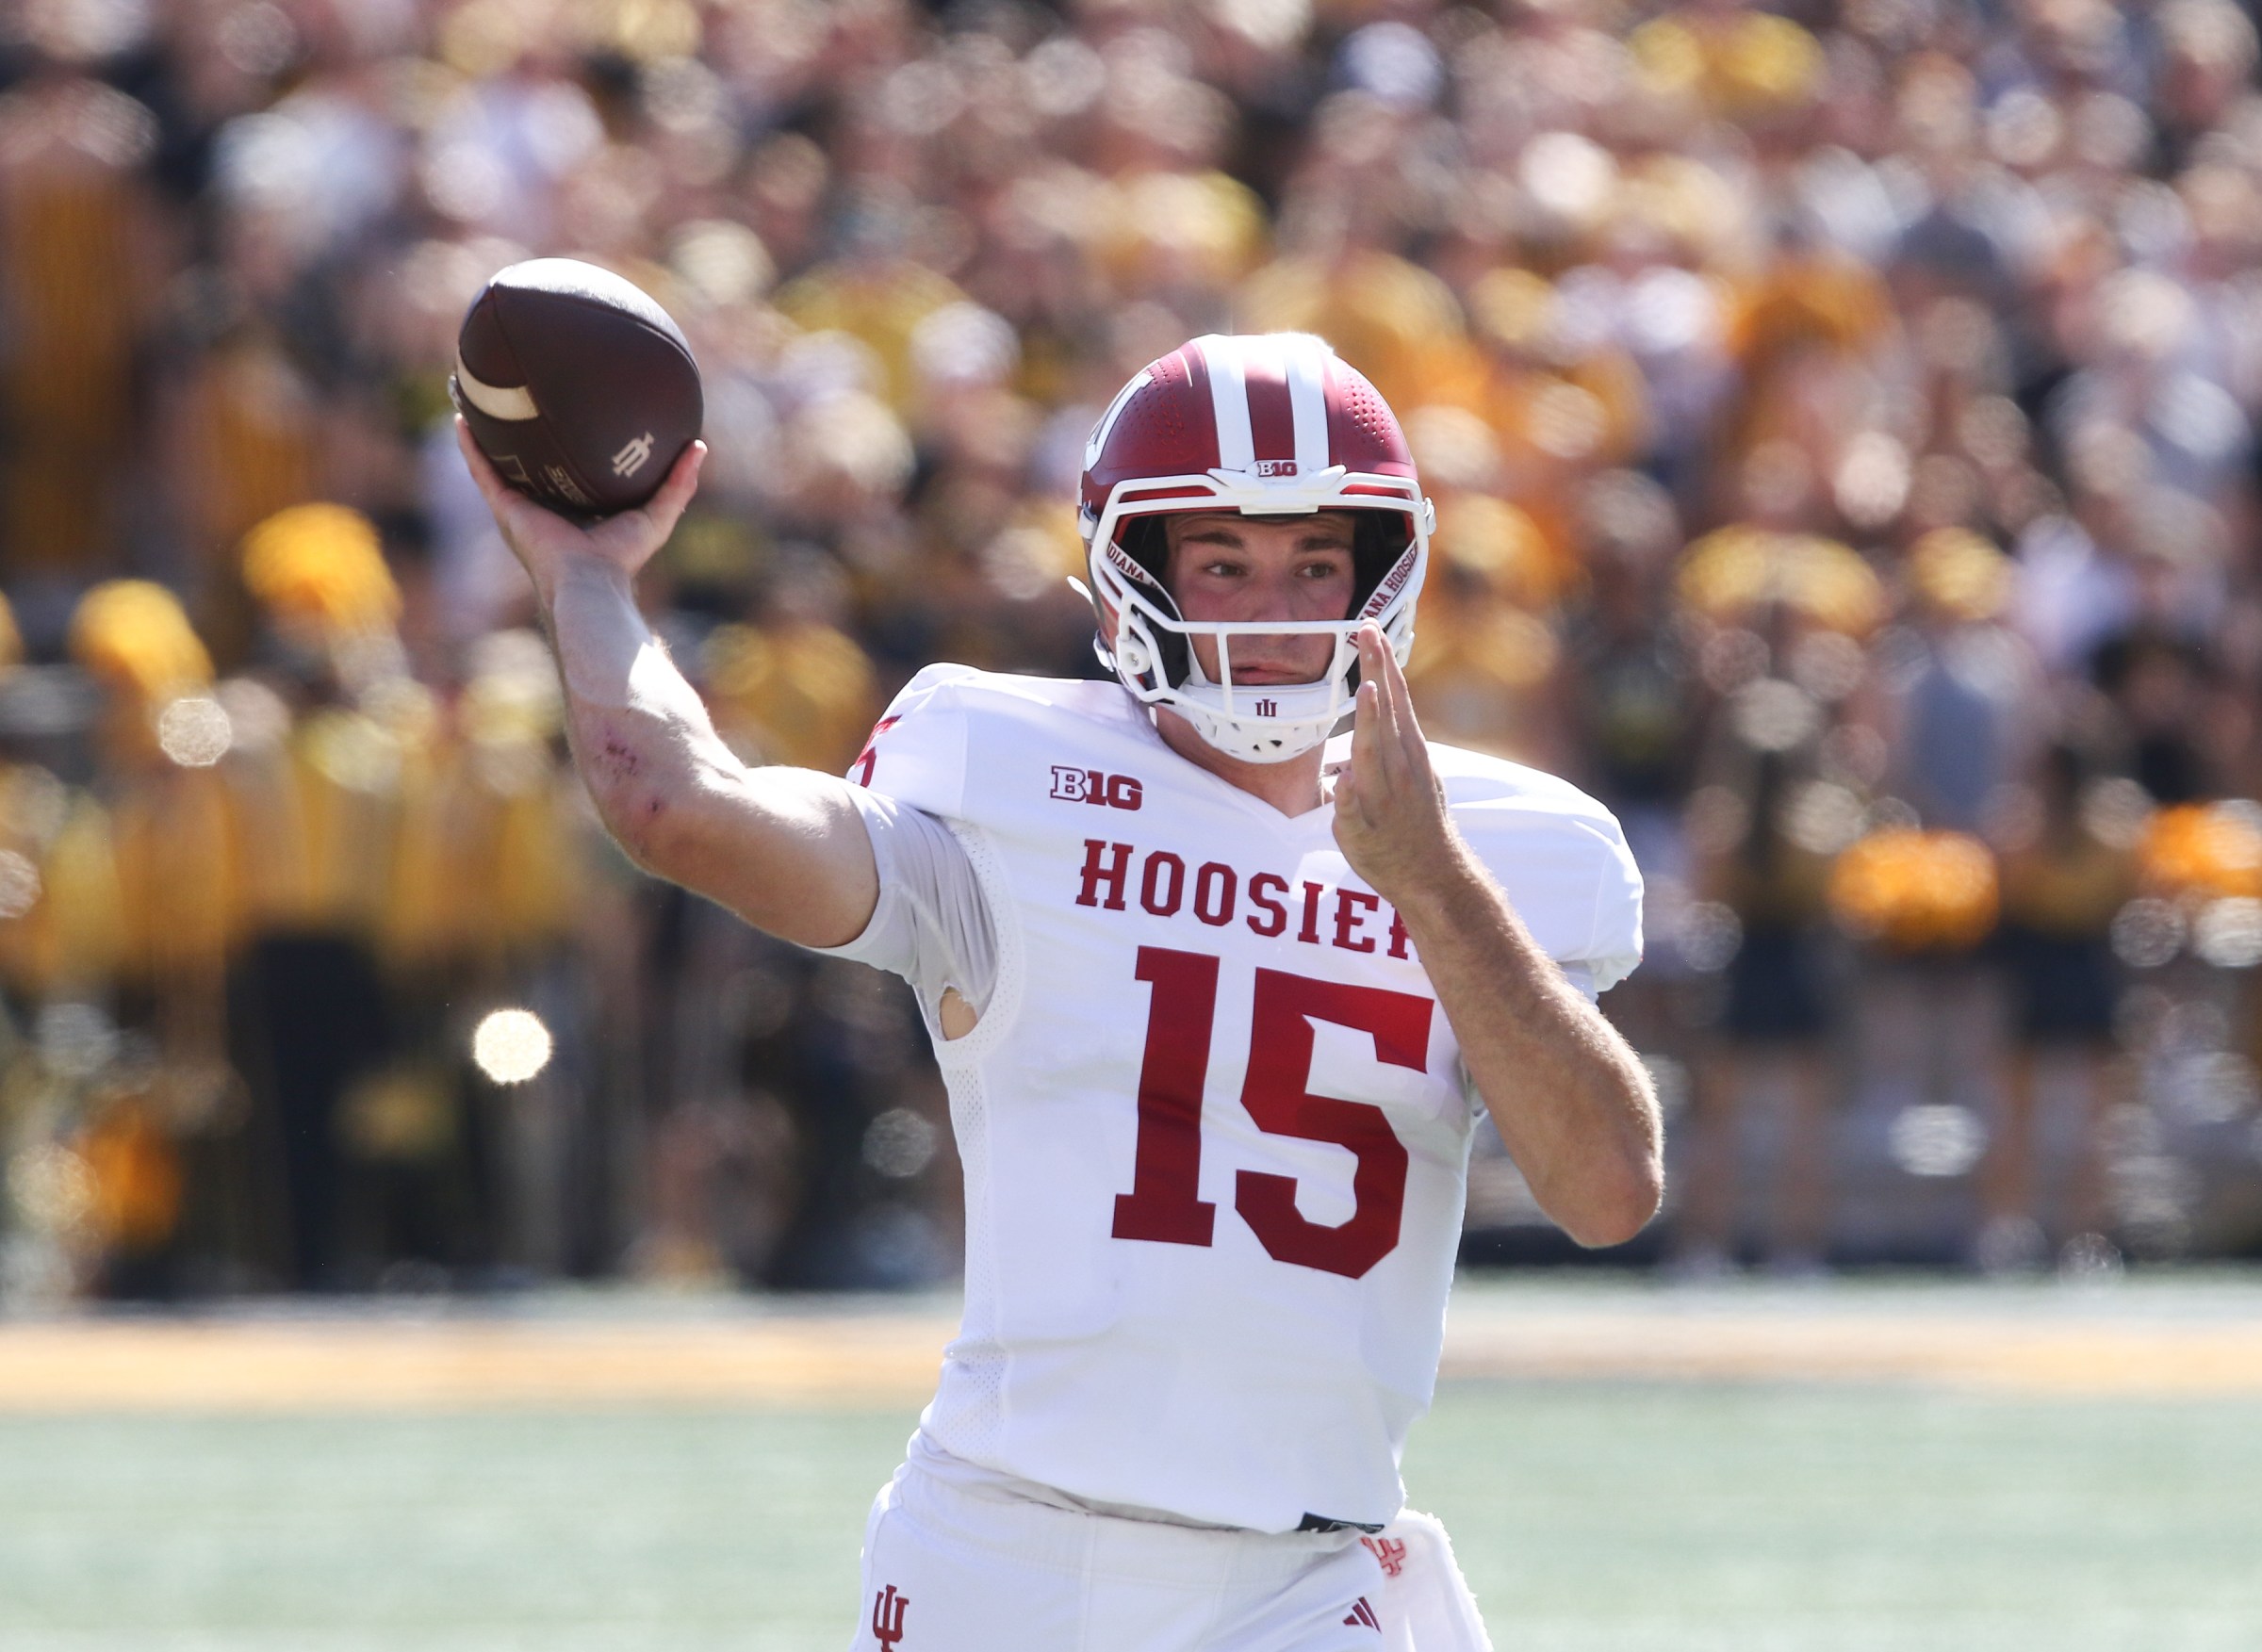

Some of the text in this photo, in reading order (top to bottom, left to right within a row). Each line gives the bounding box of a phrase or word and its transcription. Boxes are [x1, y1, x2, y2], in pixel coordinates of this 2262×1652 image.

[1106, 541, 1145, 581] DIANA
[1385, 541, 1418, 592] HOOSIE
[1111, 945, 1435, 1280] 15
